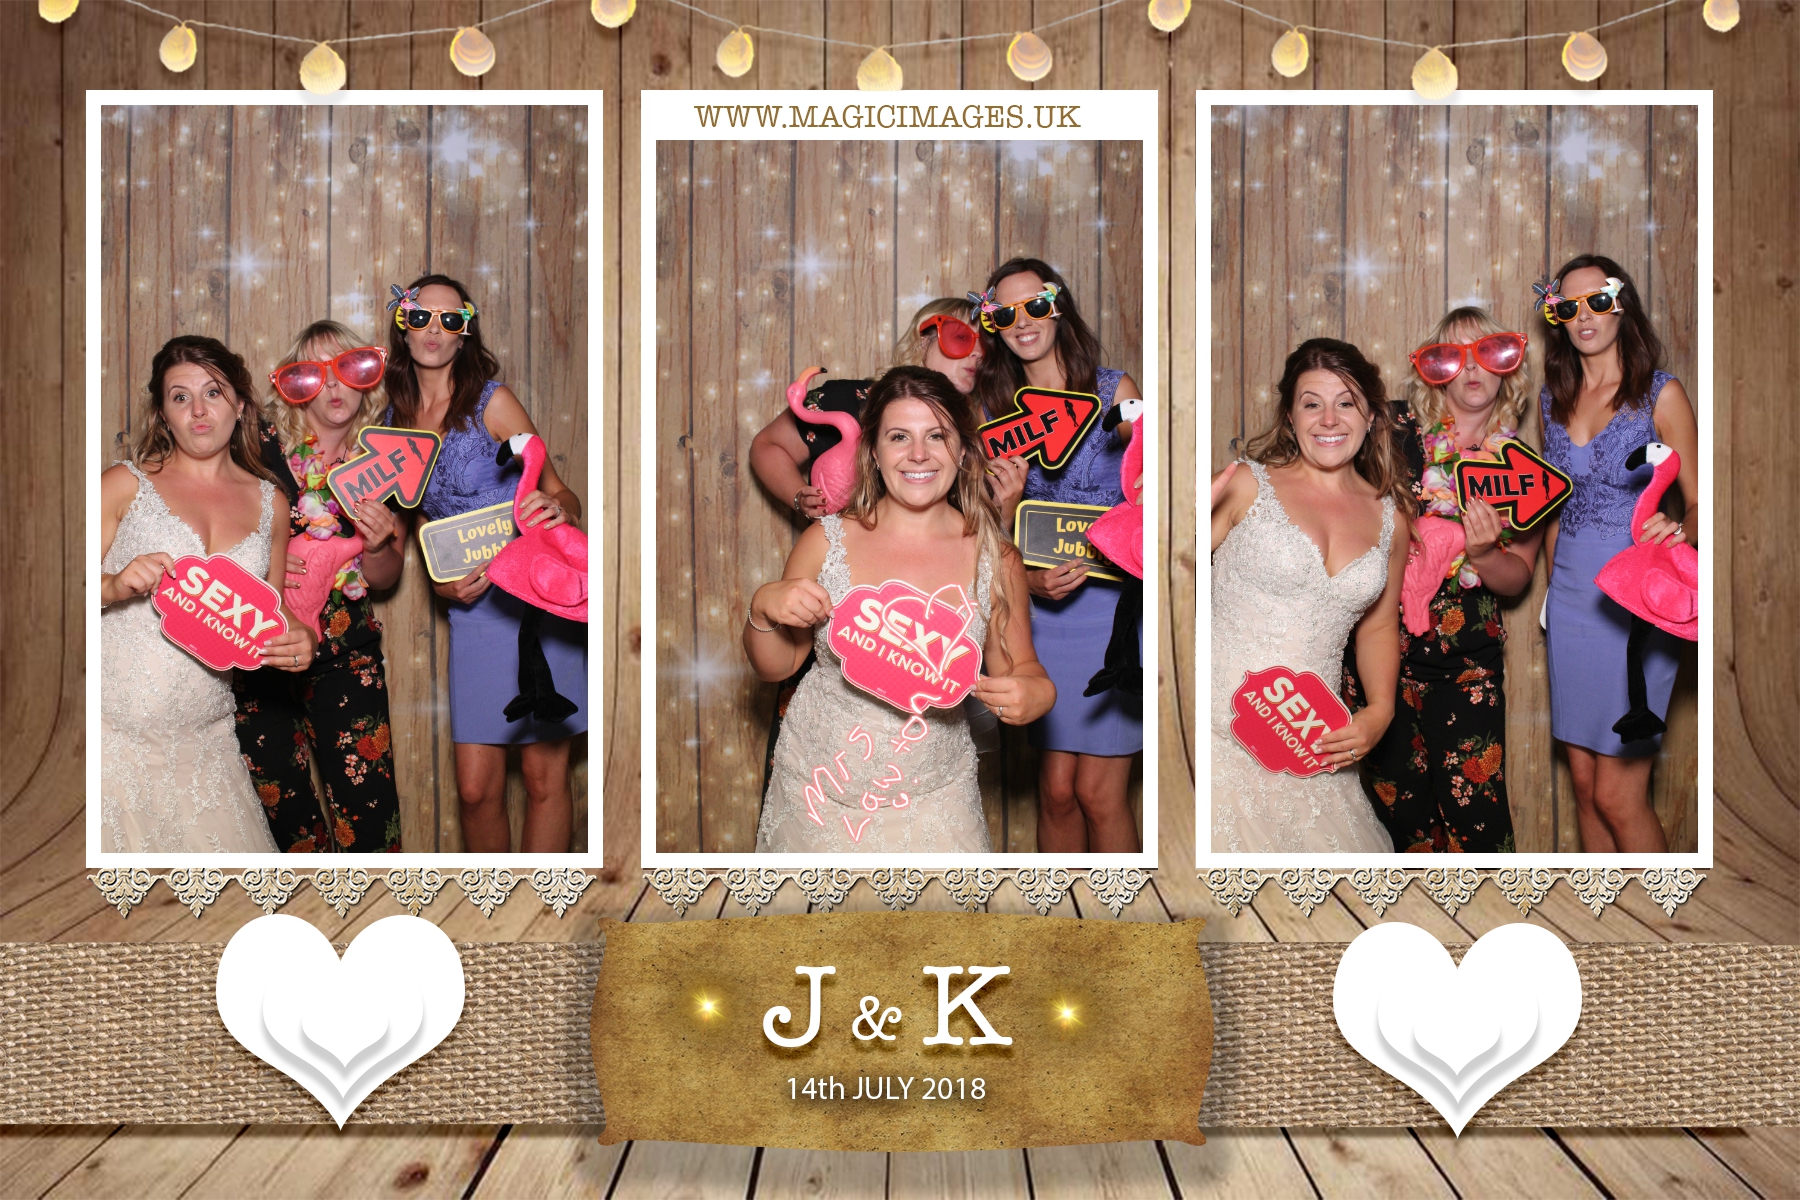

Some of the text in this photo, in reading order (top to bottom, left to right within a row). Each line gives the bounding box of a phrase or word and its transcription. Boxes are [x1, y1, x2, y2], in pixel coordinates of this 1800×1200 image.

[988, 408, 1060, 458] MILF
[342, 447, 407, 502] MILF
[1467, 473, 1536, 498] MILF
[457, 517, 514, 544] Lovely
[1056, 517, 1094, 533] Lov
[161, 587, 197, 614] AND
[195, 610, 205, 620] I
[203, 616, 250, 651] KNOW
[247, 645, 262, 660] IT
[178, 566, 279, 641] SEXY
[853, 598, 971, 672] SEXY
[837, 625, 962, 696] AND I KNOW IT
[1242, 690, 1319, 769] AND I KNOW IT
[803, 724, 874, 827] Mrs
